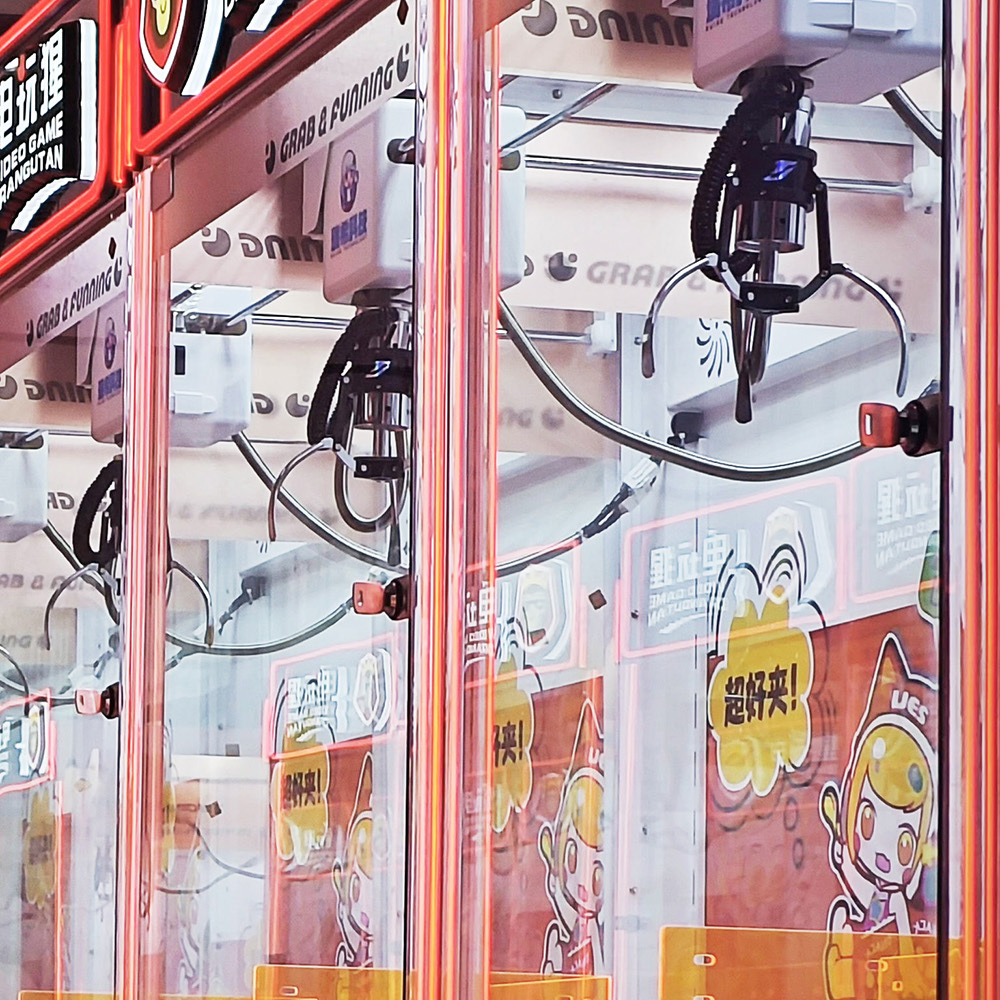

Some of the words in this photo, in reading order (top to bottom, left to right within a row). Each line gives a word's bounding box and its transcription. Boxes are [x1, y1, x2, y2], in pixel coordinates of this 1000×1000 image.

[28, 110, 63, 149] GAME
[280, 114, 316, 164] GRAB
[318, 106, 328, 135] &
[329, 57, 395, 131] FUNNING
